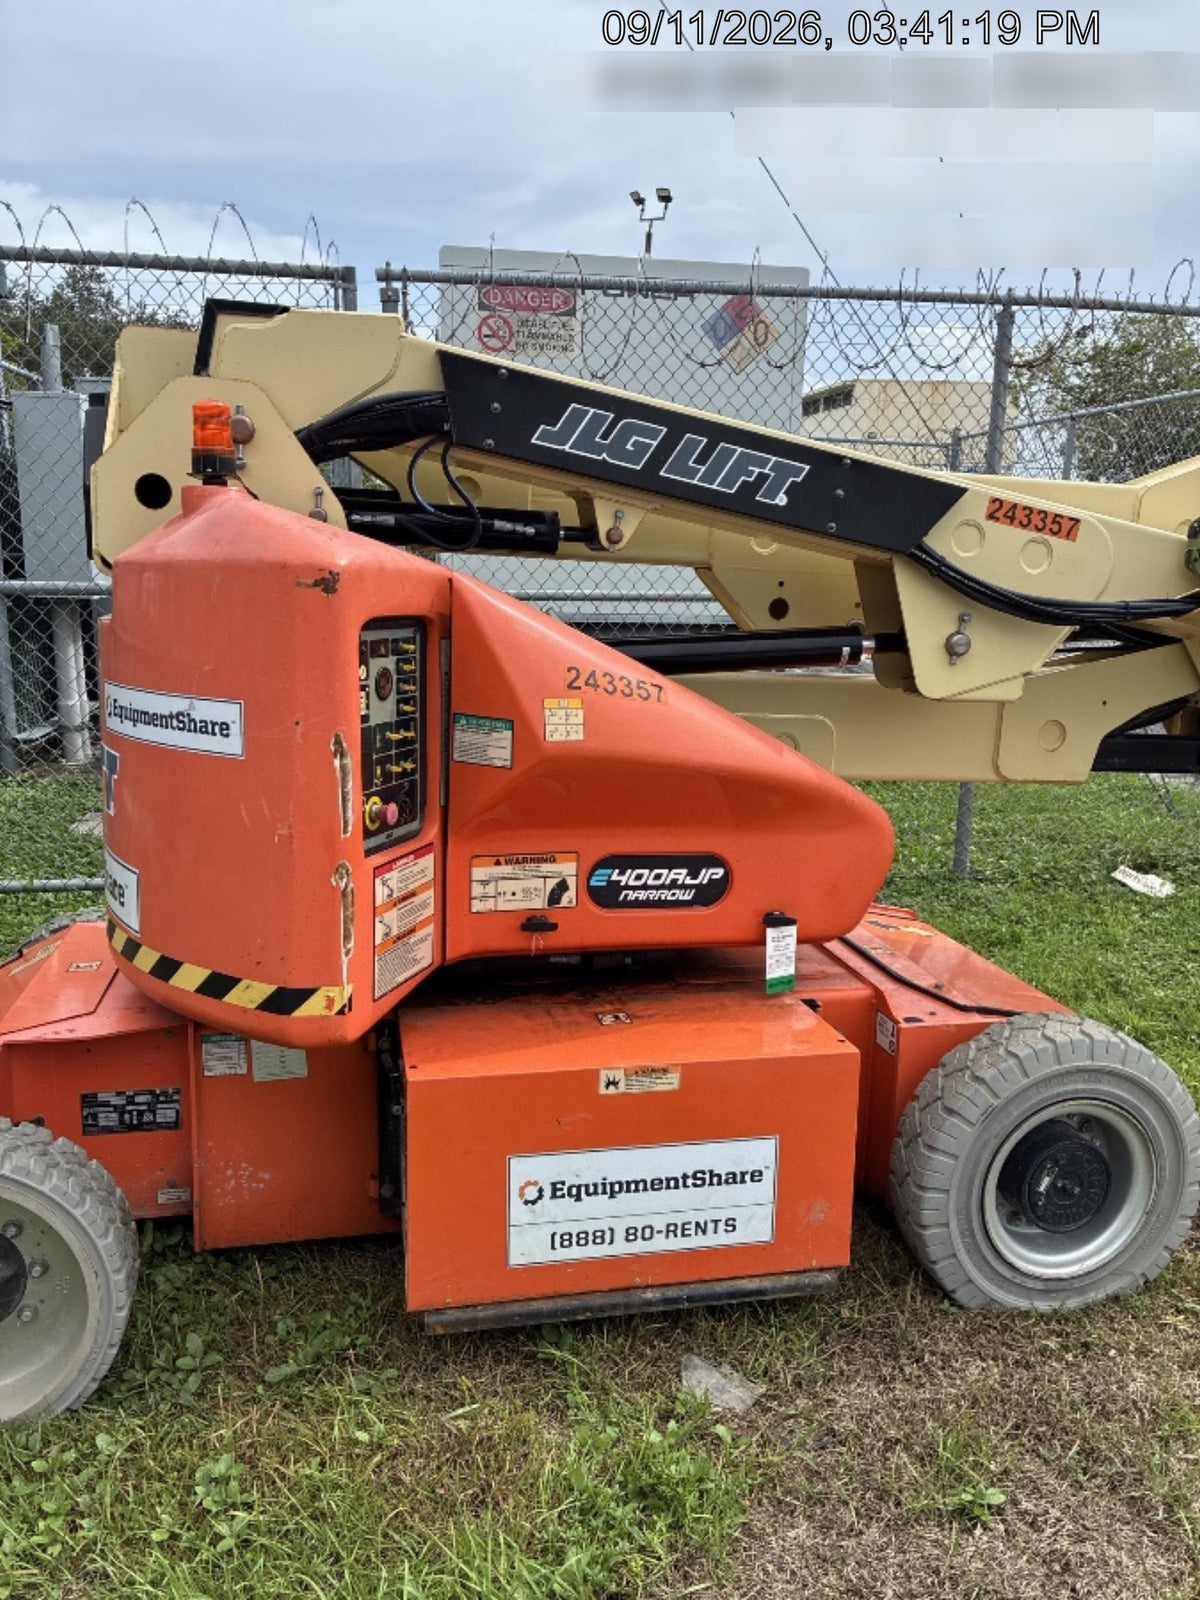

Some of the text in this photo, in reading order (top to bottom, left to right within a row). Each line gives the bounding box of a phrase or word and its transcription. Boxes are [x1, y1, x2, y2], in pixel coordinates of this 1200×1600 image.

[489, 288, 565, 309] DANGER
[531, 403, 811, 505] JLG LIFT
[987, 497, 1081, 540] 243357
[566, 665, 664, 703] 243357
[112, 698, 231, 739] EquipmentShare
[504, 854, 557, 866] WARNING
[589, 867, 726, 887] E400AJP
[619, 888, 696, 902] NARROW
[548, 1168, 764, 1203] EquipmentShare
[550, 1217, 738, 1251] (888) 80-RENTS
